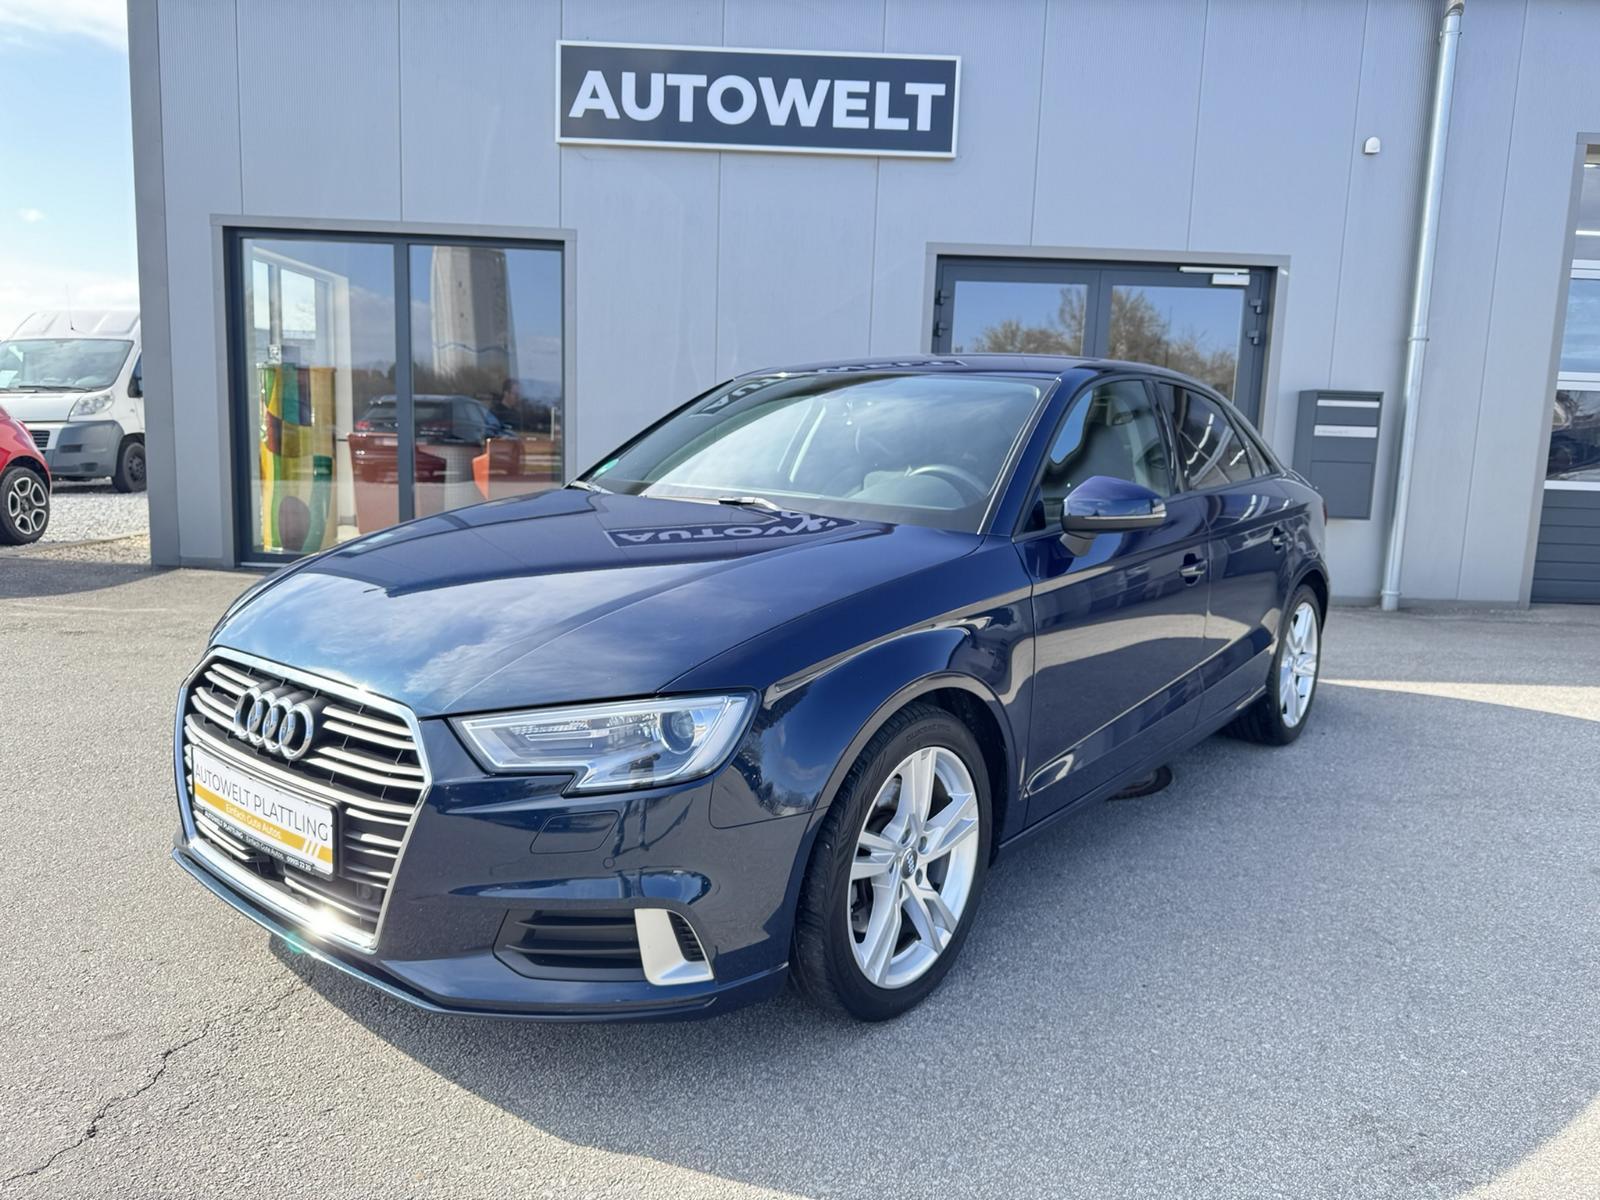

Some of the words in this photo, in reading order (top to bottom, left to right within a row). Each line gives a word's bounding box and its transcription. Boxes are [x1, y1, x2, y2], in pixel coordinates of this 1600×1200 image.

[568, 70, 946, 131] AUTOWELT
[195, 763, 252, 807] AUTOWELT
[254, 794, 328, 841] PLATTLING
